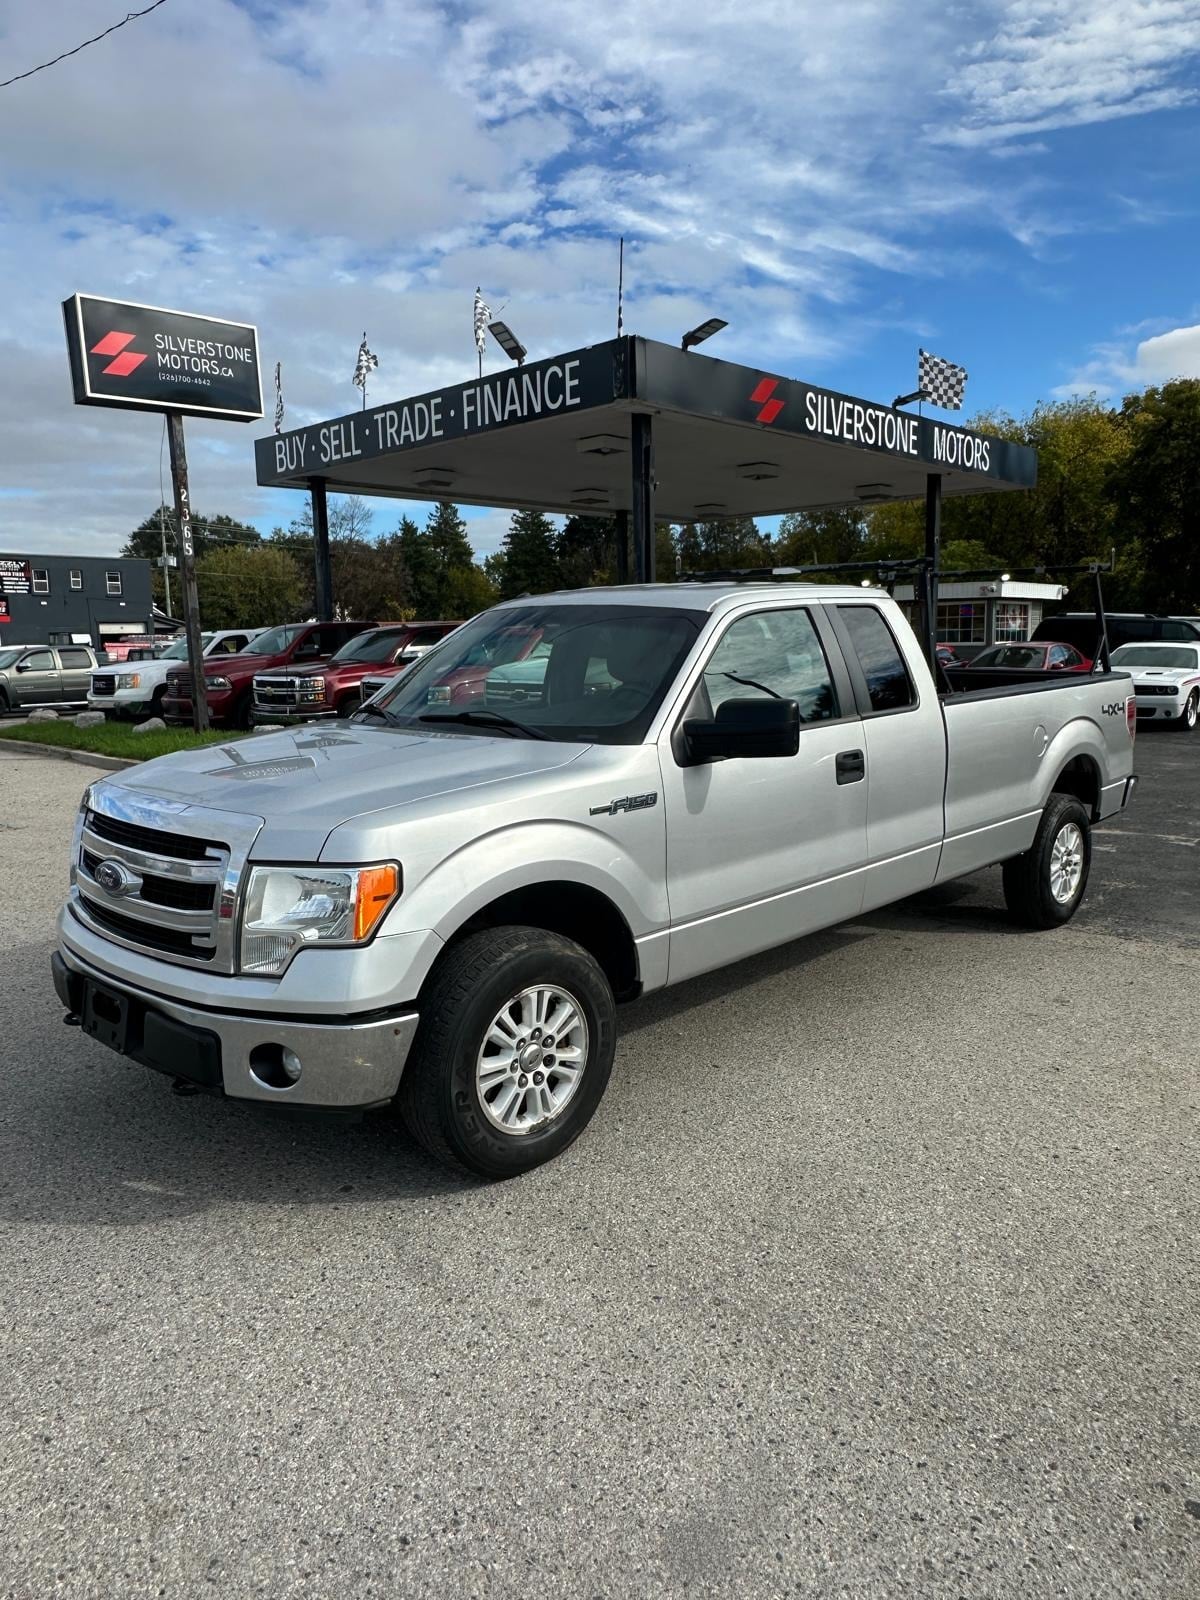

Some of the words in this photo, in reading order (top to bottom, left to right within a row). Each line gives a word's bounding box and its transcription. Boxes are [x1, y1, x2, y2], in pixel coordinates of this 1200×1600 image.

[154, 333, 253, 363] SILVERSTONE
[157, 352, 234, 378] MOTORS.CA
[275, 434, 307, 473] BUY
[320, 421, 361, 463] SELL
[373, 397, 444, 450] TRADE
[462, 359, 581, 430] FINANCE
[805, 391, 918, 455] SILVERSTONE
[933, 426, 990, 472] MOTORS
[180, 488, 193, 556] 2365
